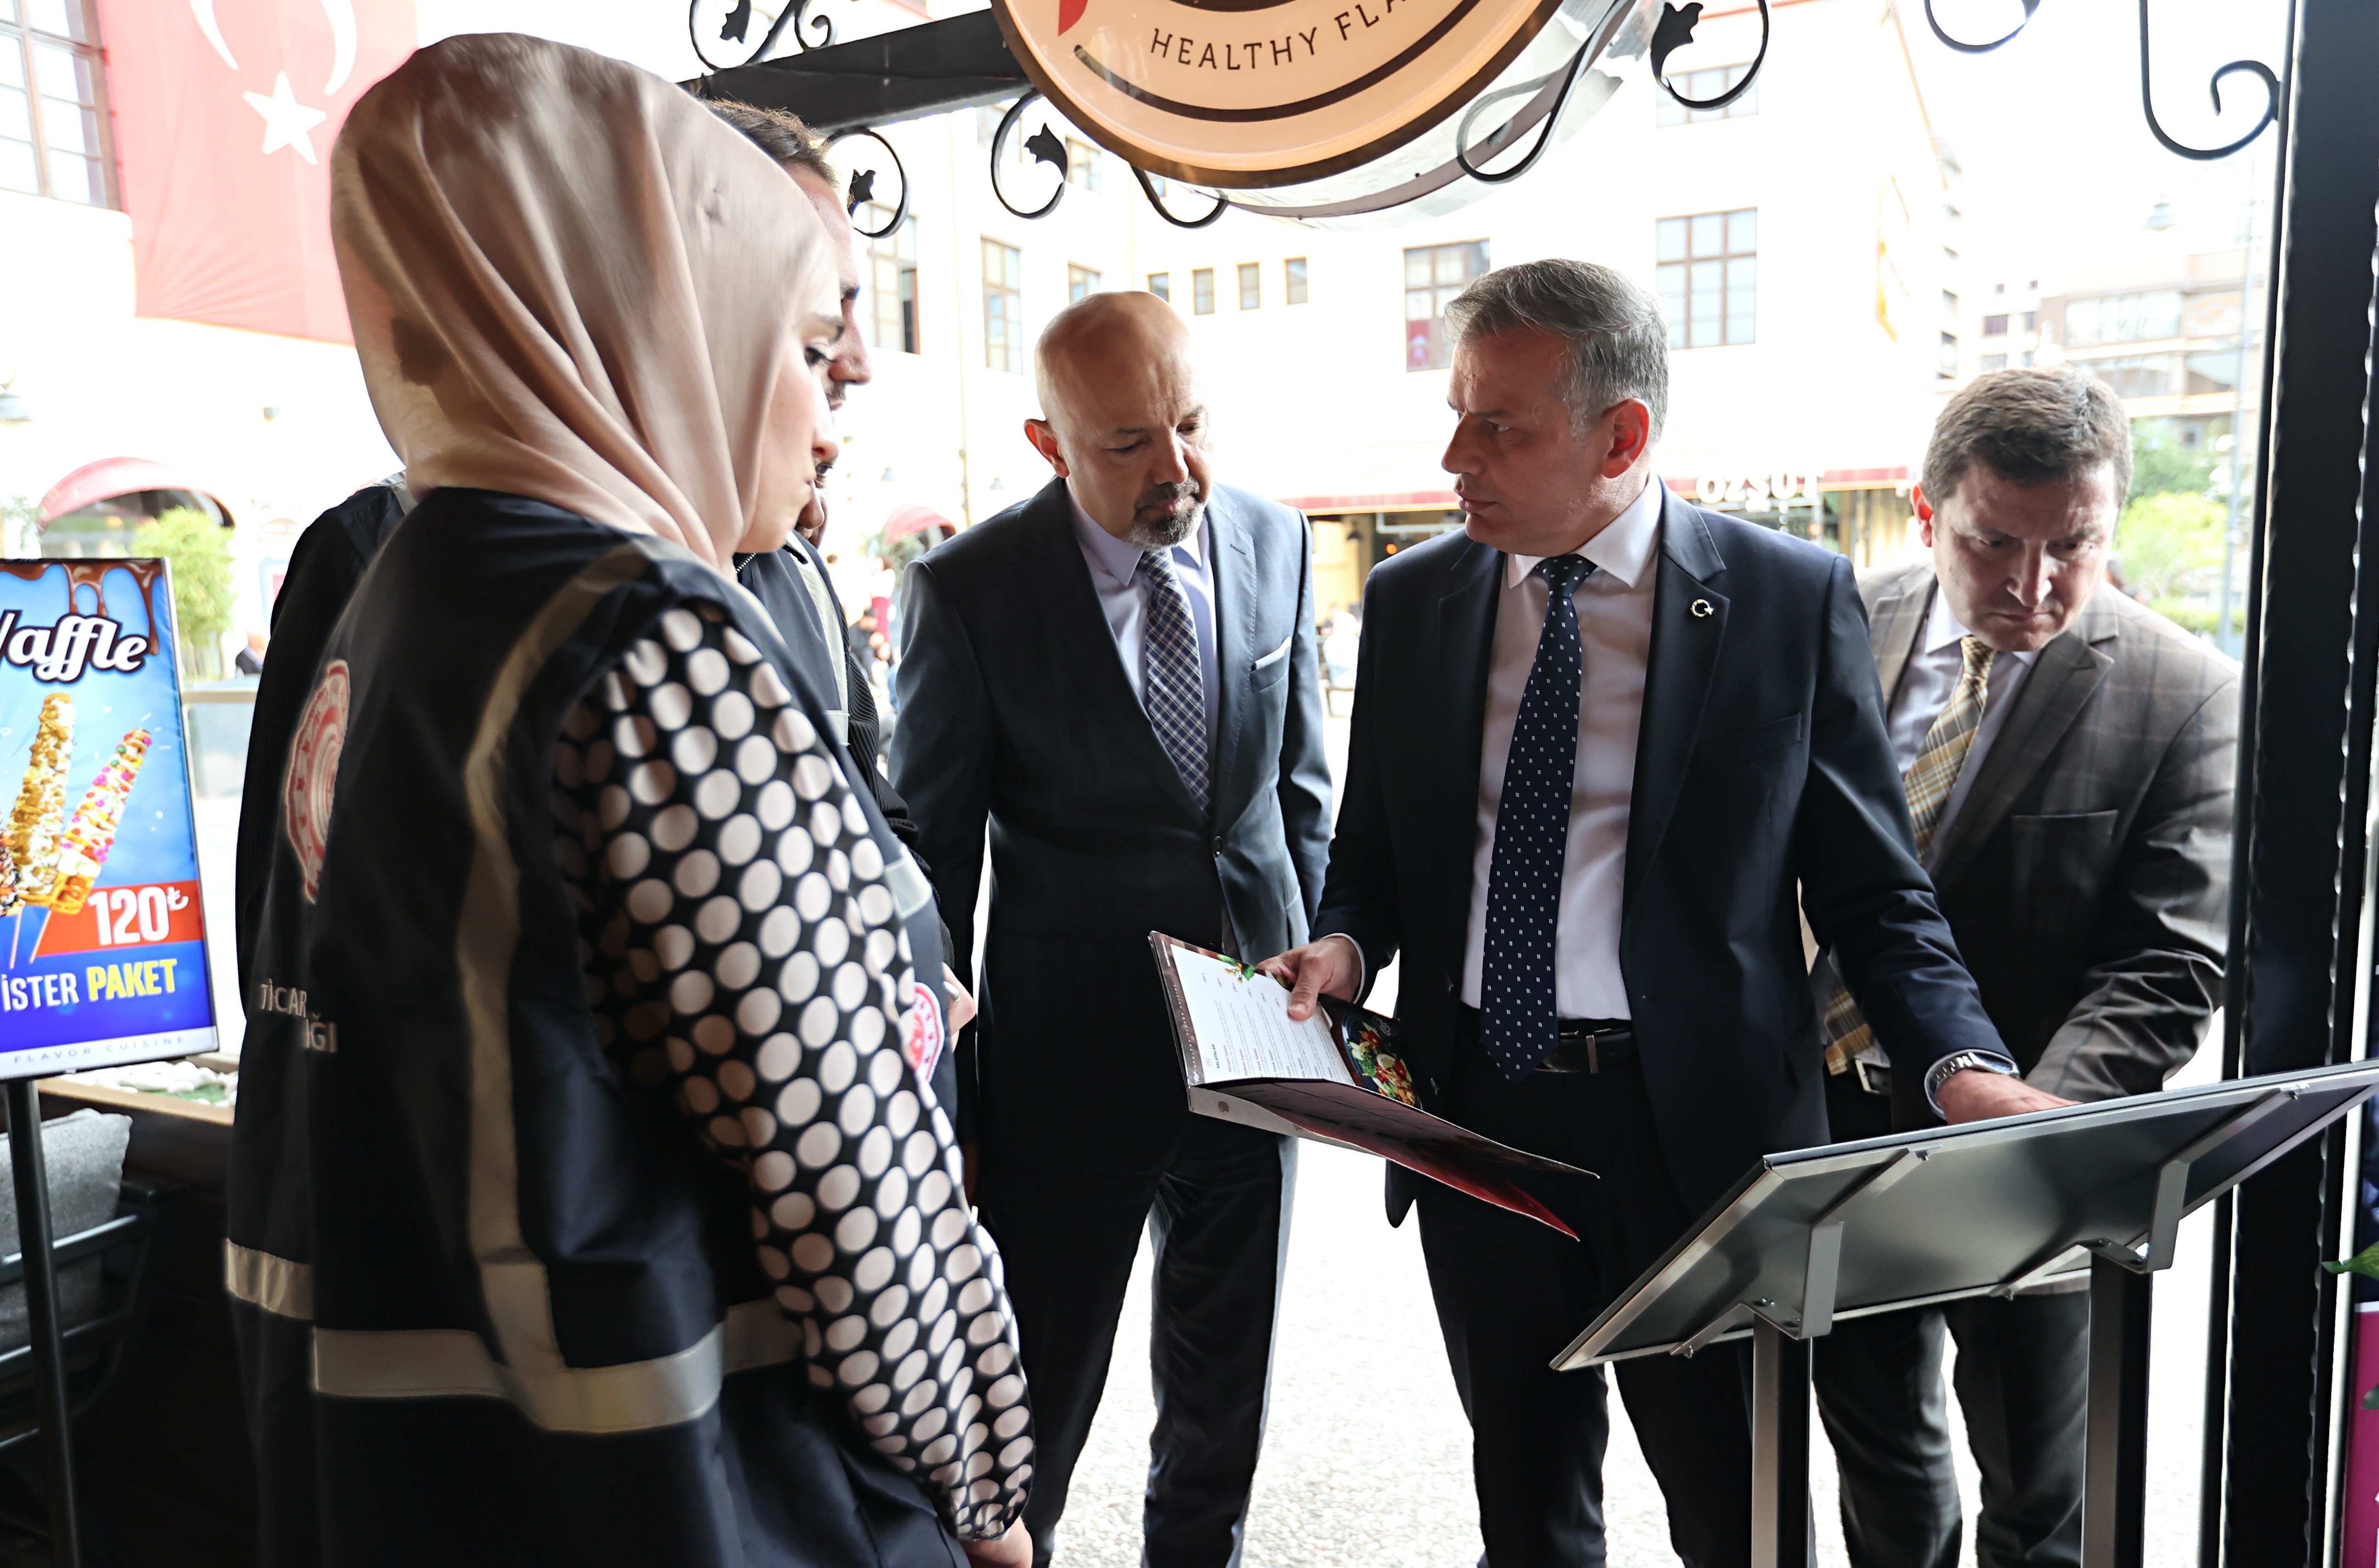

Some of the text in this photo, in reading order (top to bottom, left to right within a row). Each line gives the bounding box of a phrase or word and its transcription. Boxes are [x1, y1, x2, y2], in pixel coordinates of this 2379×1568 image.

[1151, 27, 1317, 70] HEALTHY
[1, 958, 178, 1012] İSTER PAKET
[14, 1036, 185, 1064] FLAVOR CUISINE
[1211, 1043, 1220, 1070] SALATALAR
